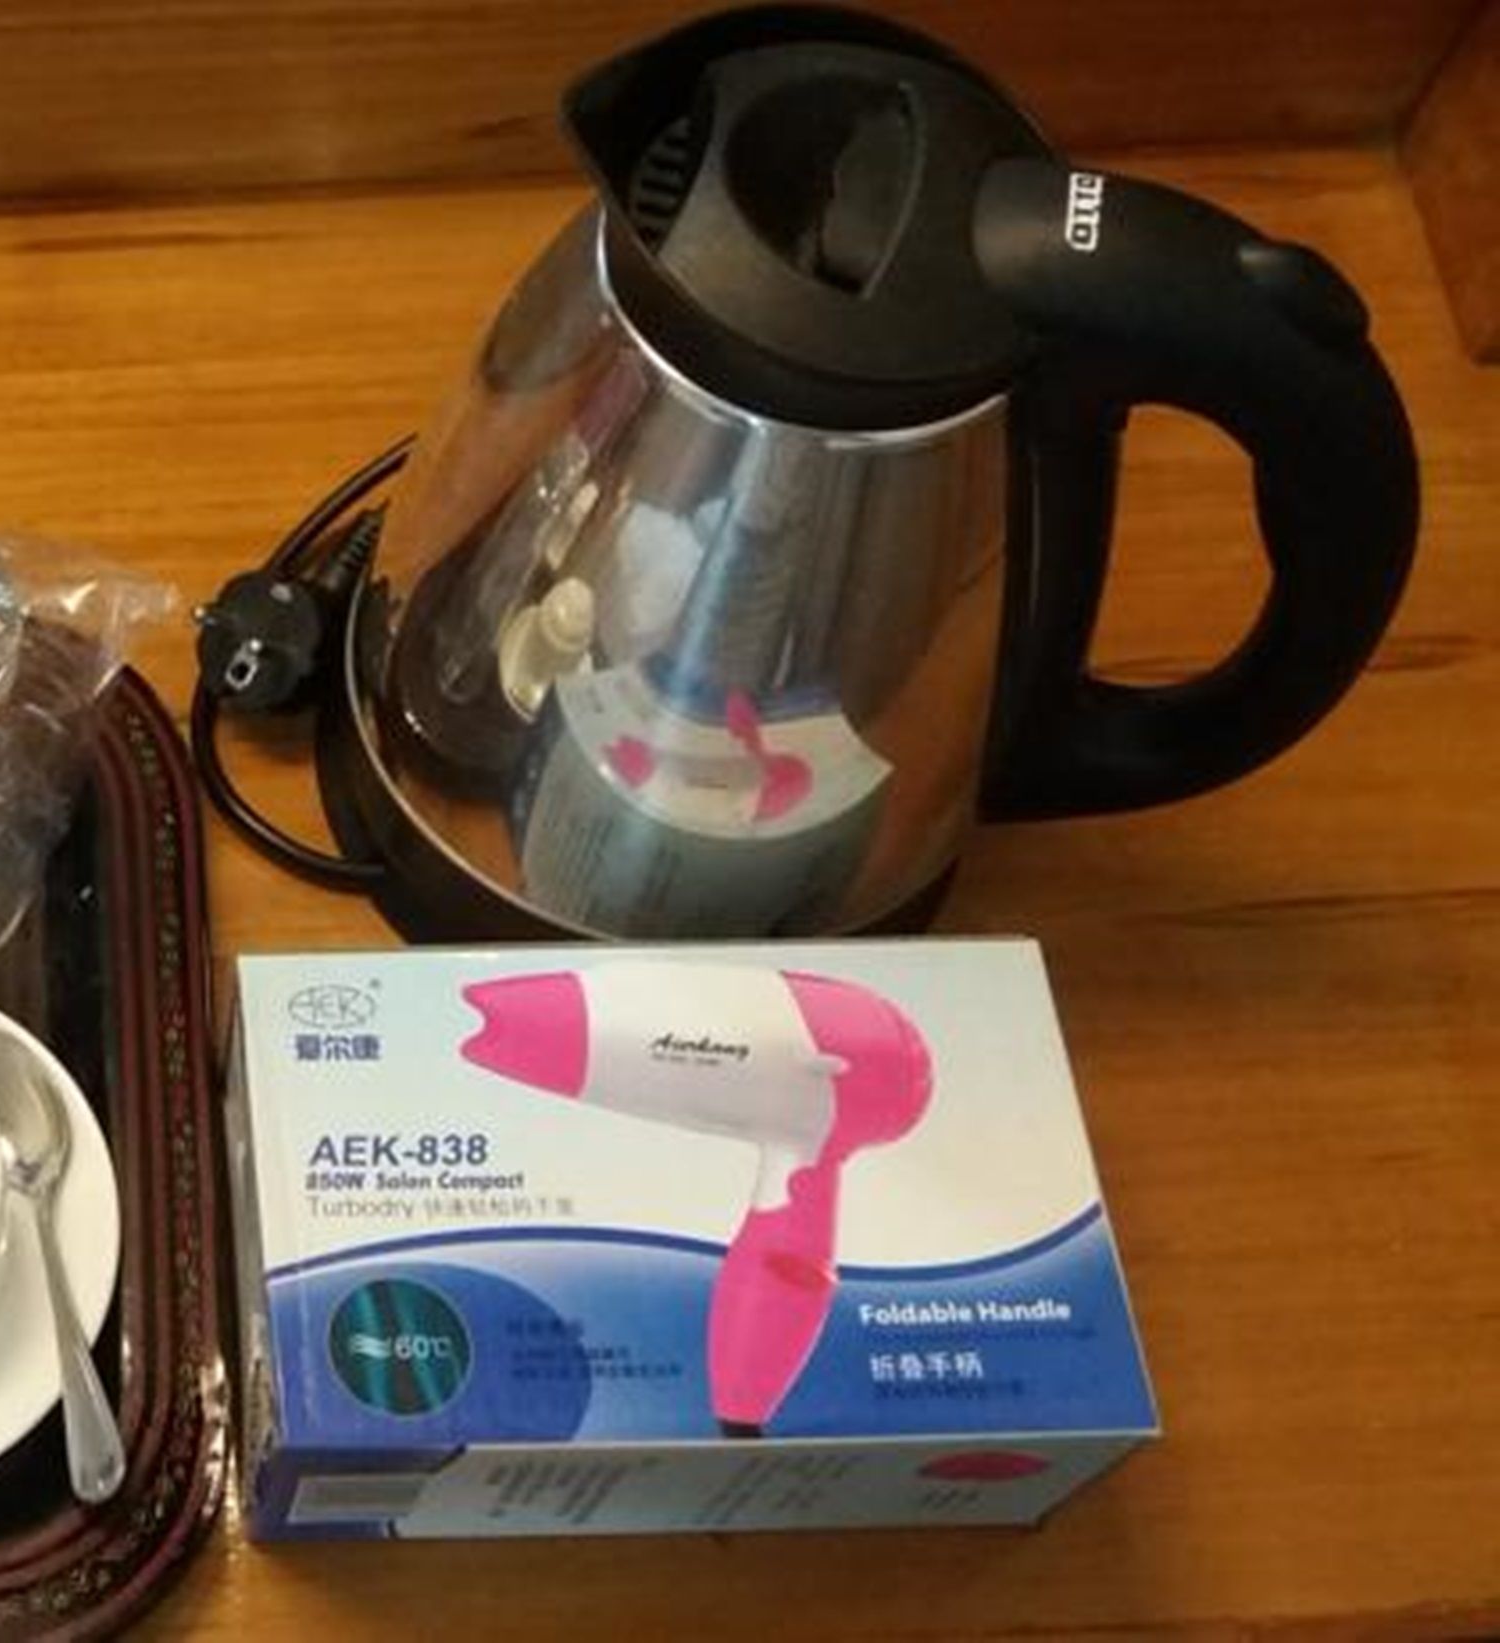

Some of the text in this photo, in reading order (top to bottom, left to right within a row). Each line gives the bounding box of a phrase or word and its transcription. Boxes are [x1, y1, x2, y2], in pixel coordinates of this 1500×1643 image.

[308, 1134, 490, 1167] AEK-838
[305, 1172, 366, 1191] 850W
[437, 1171, 525, 1192] Compact
[858, 1299, 1072, 1326] Foldable Handle
